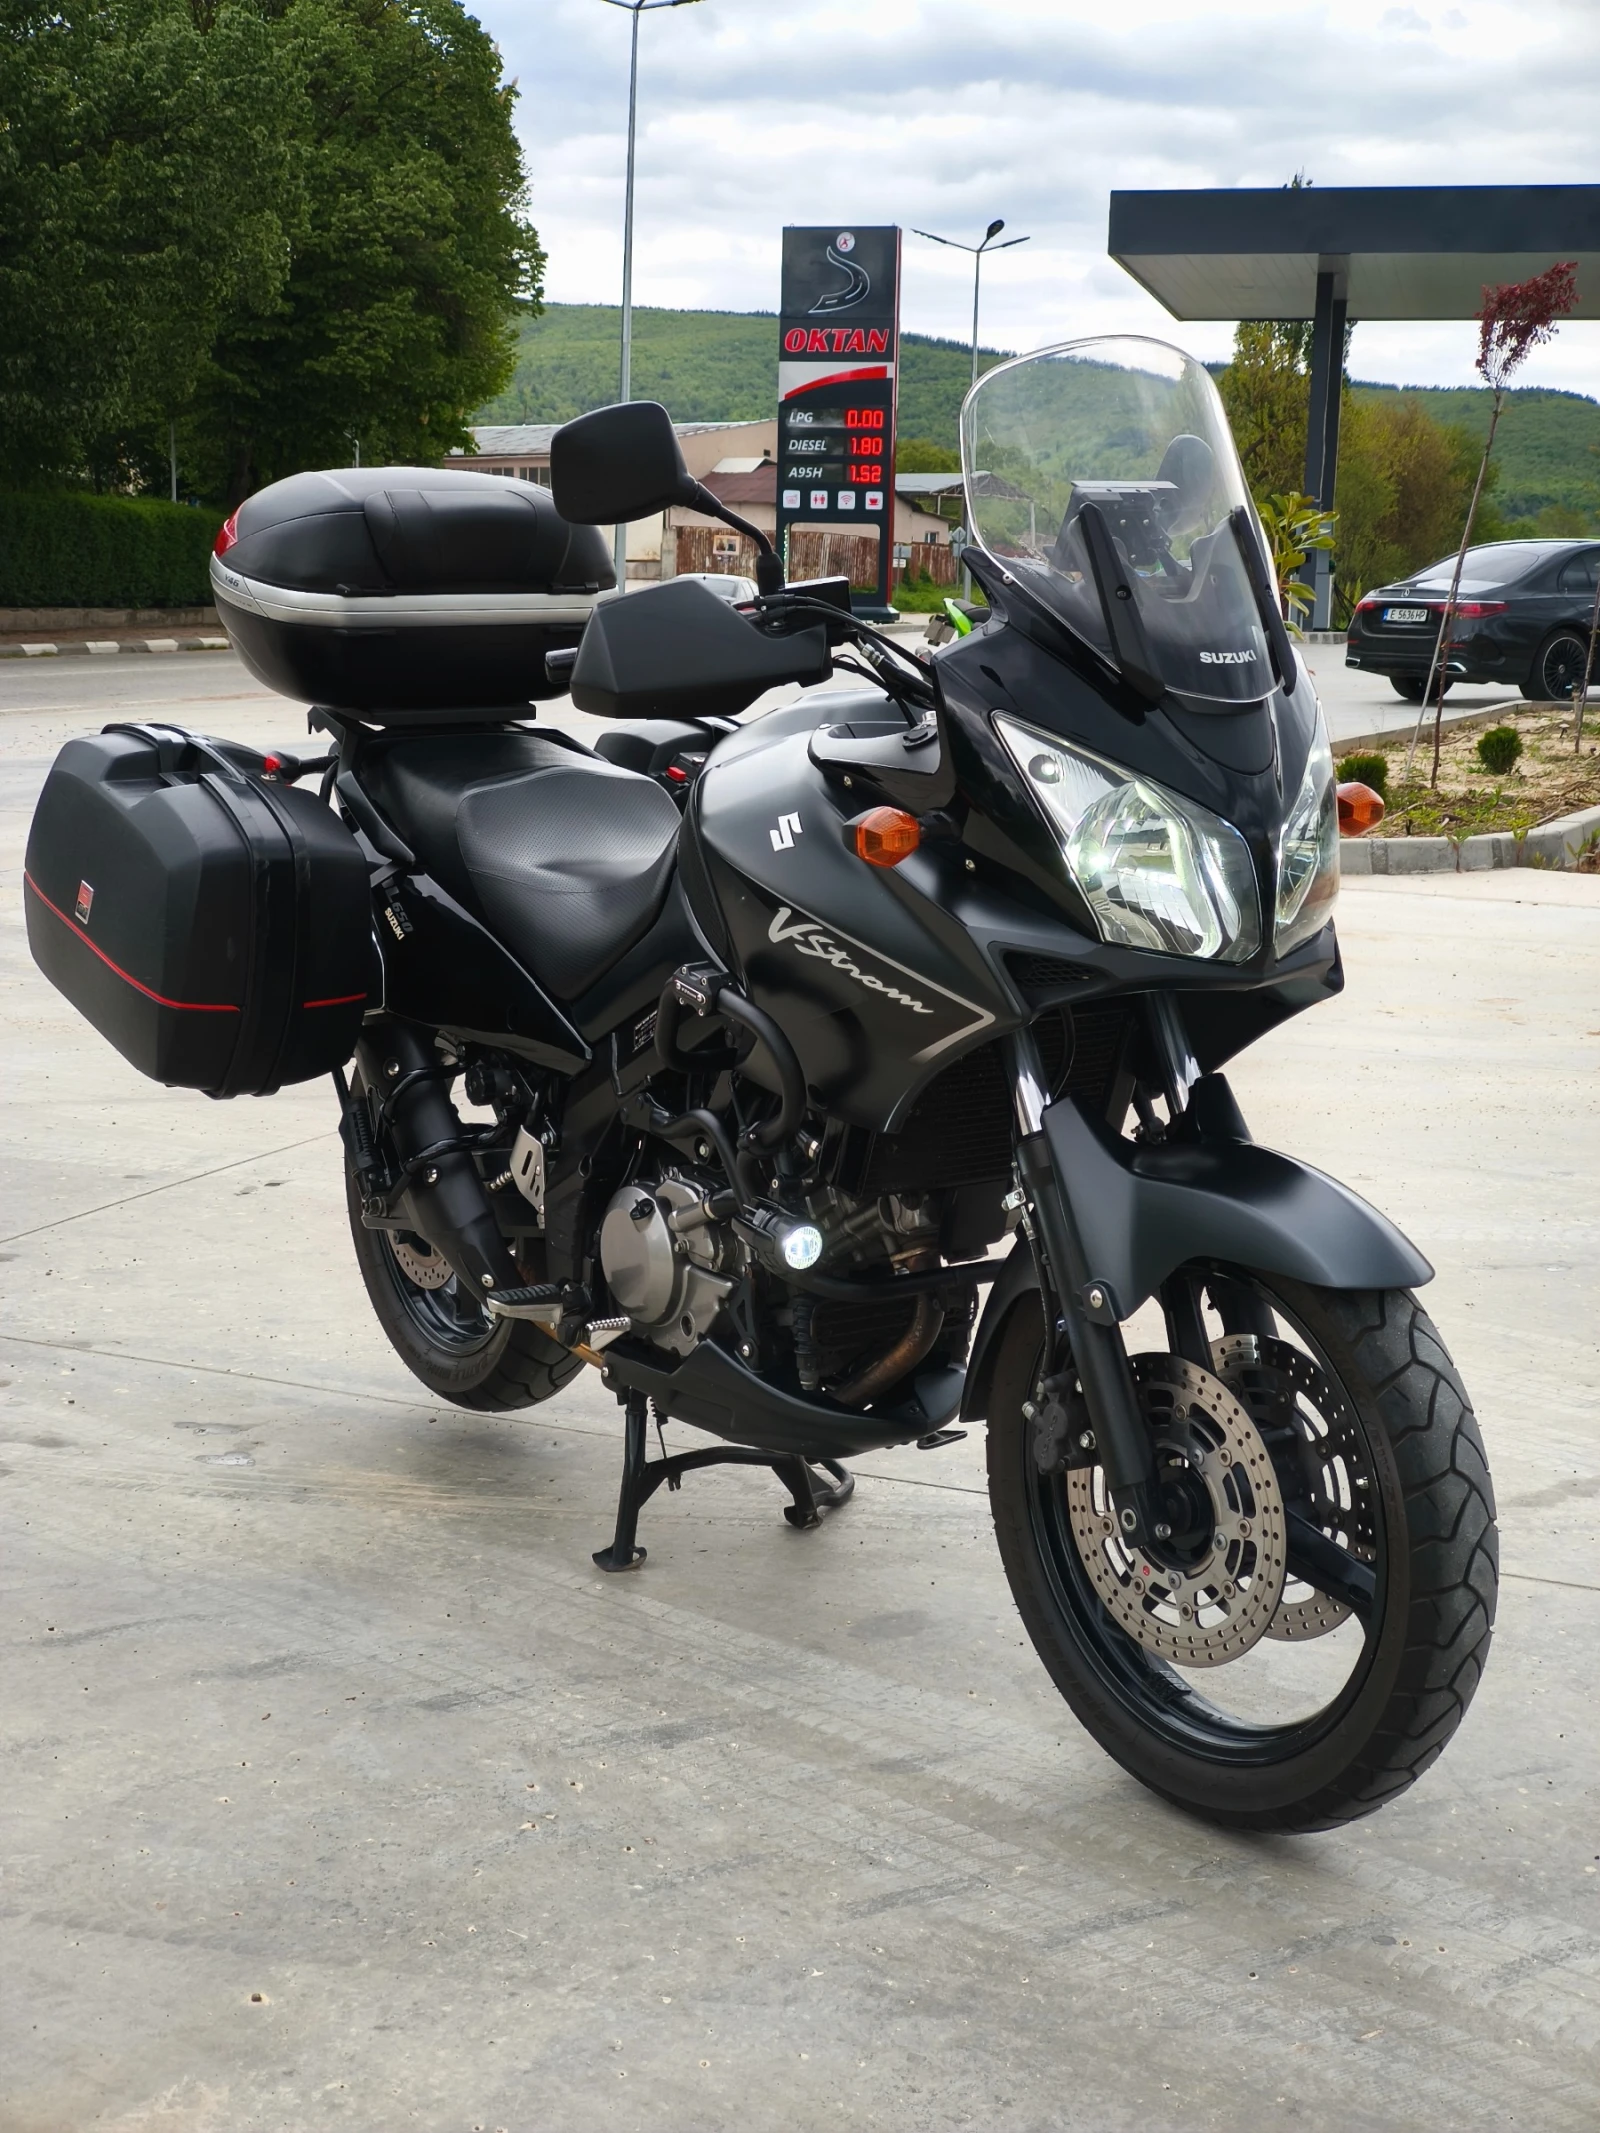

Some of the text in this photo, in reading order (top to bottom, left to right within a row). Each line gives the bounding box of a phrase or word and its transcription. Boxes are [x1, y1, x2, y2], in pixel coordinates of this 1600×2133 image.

[785, 328, 890, 352] OKTAN
[789, 409, 883, 428] LPG 0.00
[788, 437, 882, 455] DIESEL 1.80
[788, 465, 882, 482] A95H 1.52
[1200, 649, 1257, 664] SUZUKI
[384, 906, 405, 940] SUZUKI
